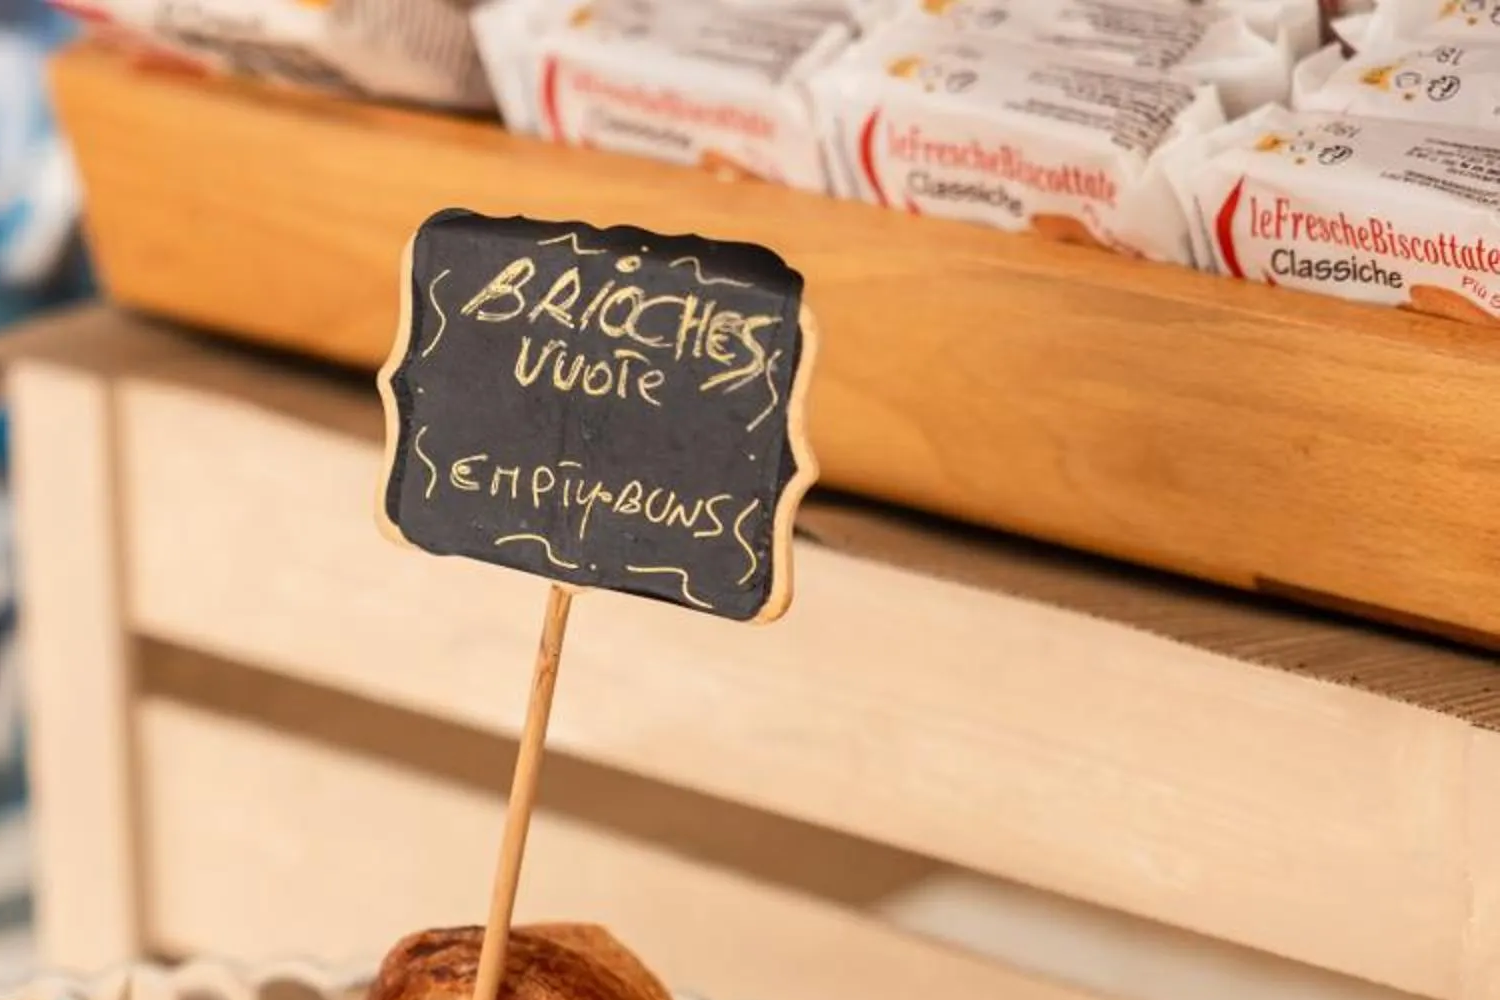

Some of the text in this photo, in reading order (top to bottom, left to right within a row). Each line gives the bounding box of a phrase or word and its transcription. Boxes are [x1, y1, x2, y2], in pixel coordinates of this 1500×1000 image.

[1250, 197, 1500, 276] leFrescheBiscottate
[1271, 248, 1403, 289] Classiche
[460, 256, 783, 393] BRIOCHES
